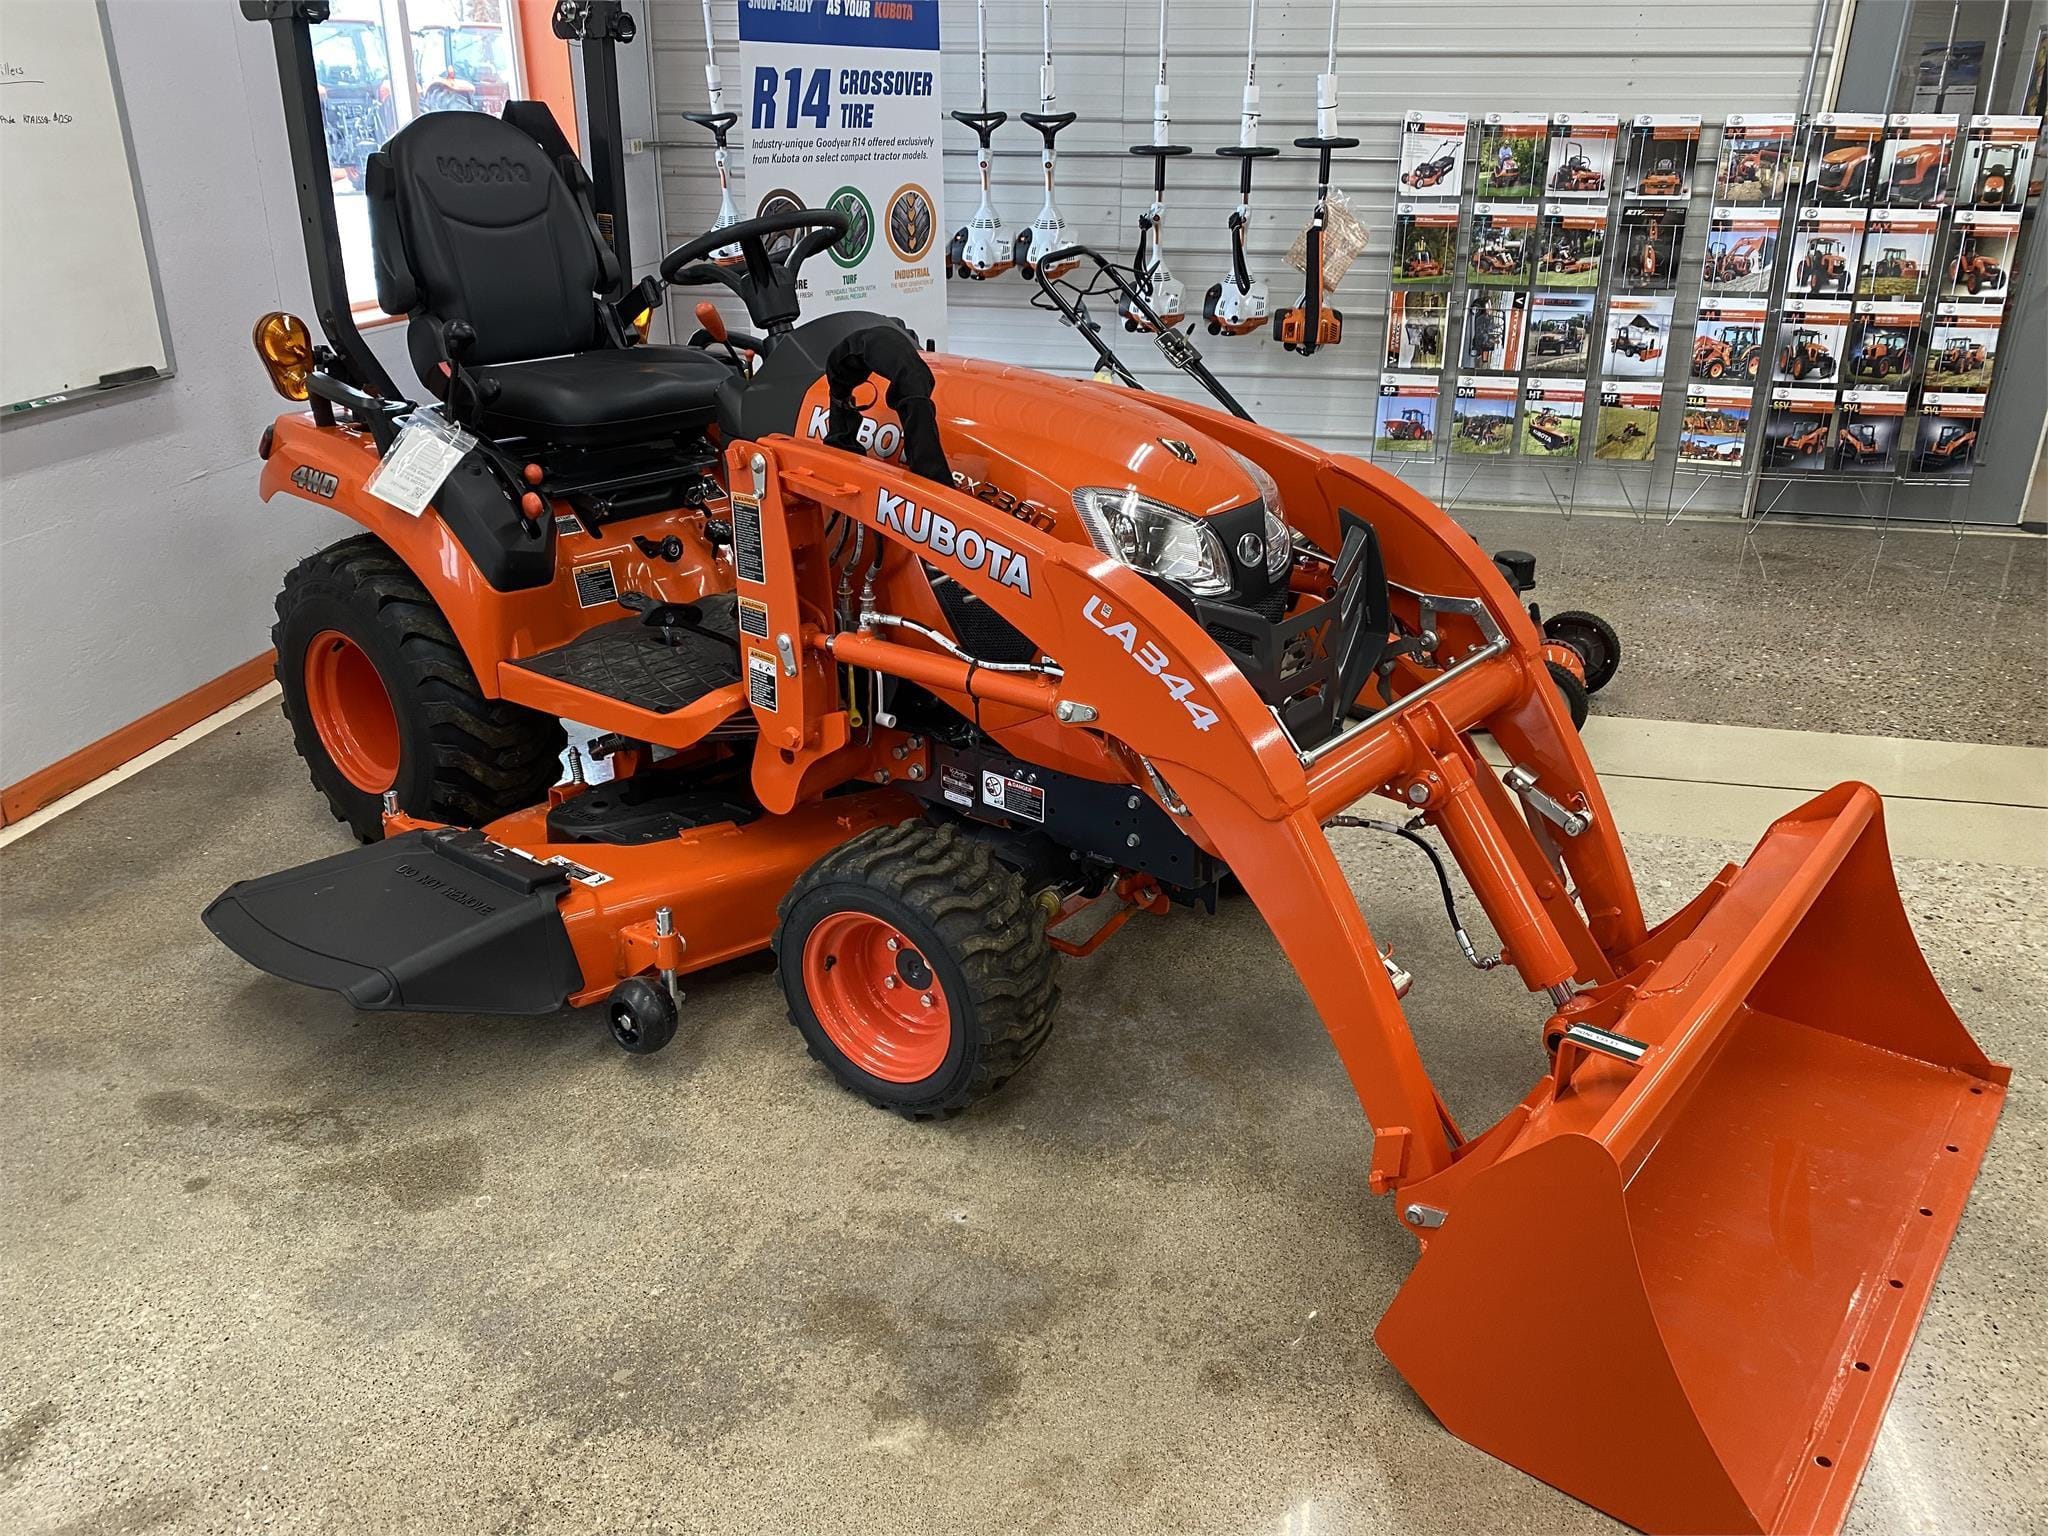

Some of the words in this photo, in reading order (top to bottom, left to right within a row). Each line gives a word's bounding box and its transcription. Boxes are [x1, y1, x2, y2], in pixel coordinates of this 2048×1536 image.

[826, 0, 840, 15] AS
[844, 0, 870, 18] YOUR
[874, 1, 913, 20] KUBOTA
[839, 69, 933, 96] CROSSOVER
[751, 66, 831, 129] R14
[840, 103, 874, 129] TIRE
[1410, 123, 1420, 132] W
[752, 138, 814, 150] Industry-unique
[816, 137, 850, 150] Goodyear
[852, 137, 866, 147] R14
[867, 136, 896, 147] offered
[896, 136, 935, 148] exclusively
[752, 154, 770, 165] from
[771, 153, 800, 164] Kubota
[802, 154, 814, 163] on
[815, 152, 839, 162] select
[840, 151, 872, 163] compact
[873, 151, 901, 161] tractor
[901, 150, 929, 161] models.
[843, 274, 858, 285] TURF
[894, 267, 930, 280] INDUSTRIAL
[1383, 386, 1396, 395] SP
[1458, 389, 1475, 398] DM
[1528, 390, 1541, 399] HT
[1603, 394, 1618, 403] HT
[1773, 401, 1790, 410] SSV
[1843, 403, 1860, 412] SVL
[291, 464, 339, 499] 4WD
[876, 487, 1032, 598] KUBOTA
[1082, 594, 1220, 732] LA344
[1011, 781, 1033, 793] DANGER
[395, 863, 419, 877] DO
[416, 875, 445, 890] NOT
[441, 886, 497, 916] REMOVE
